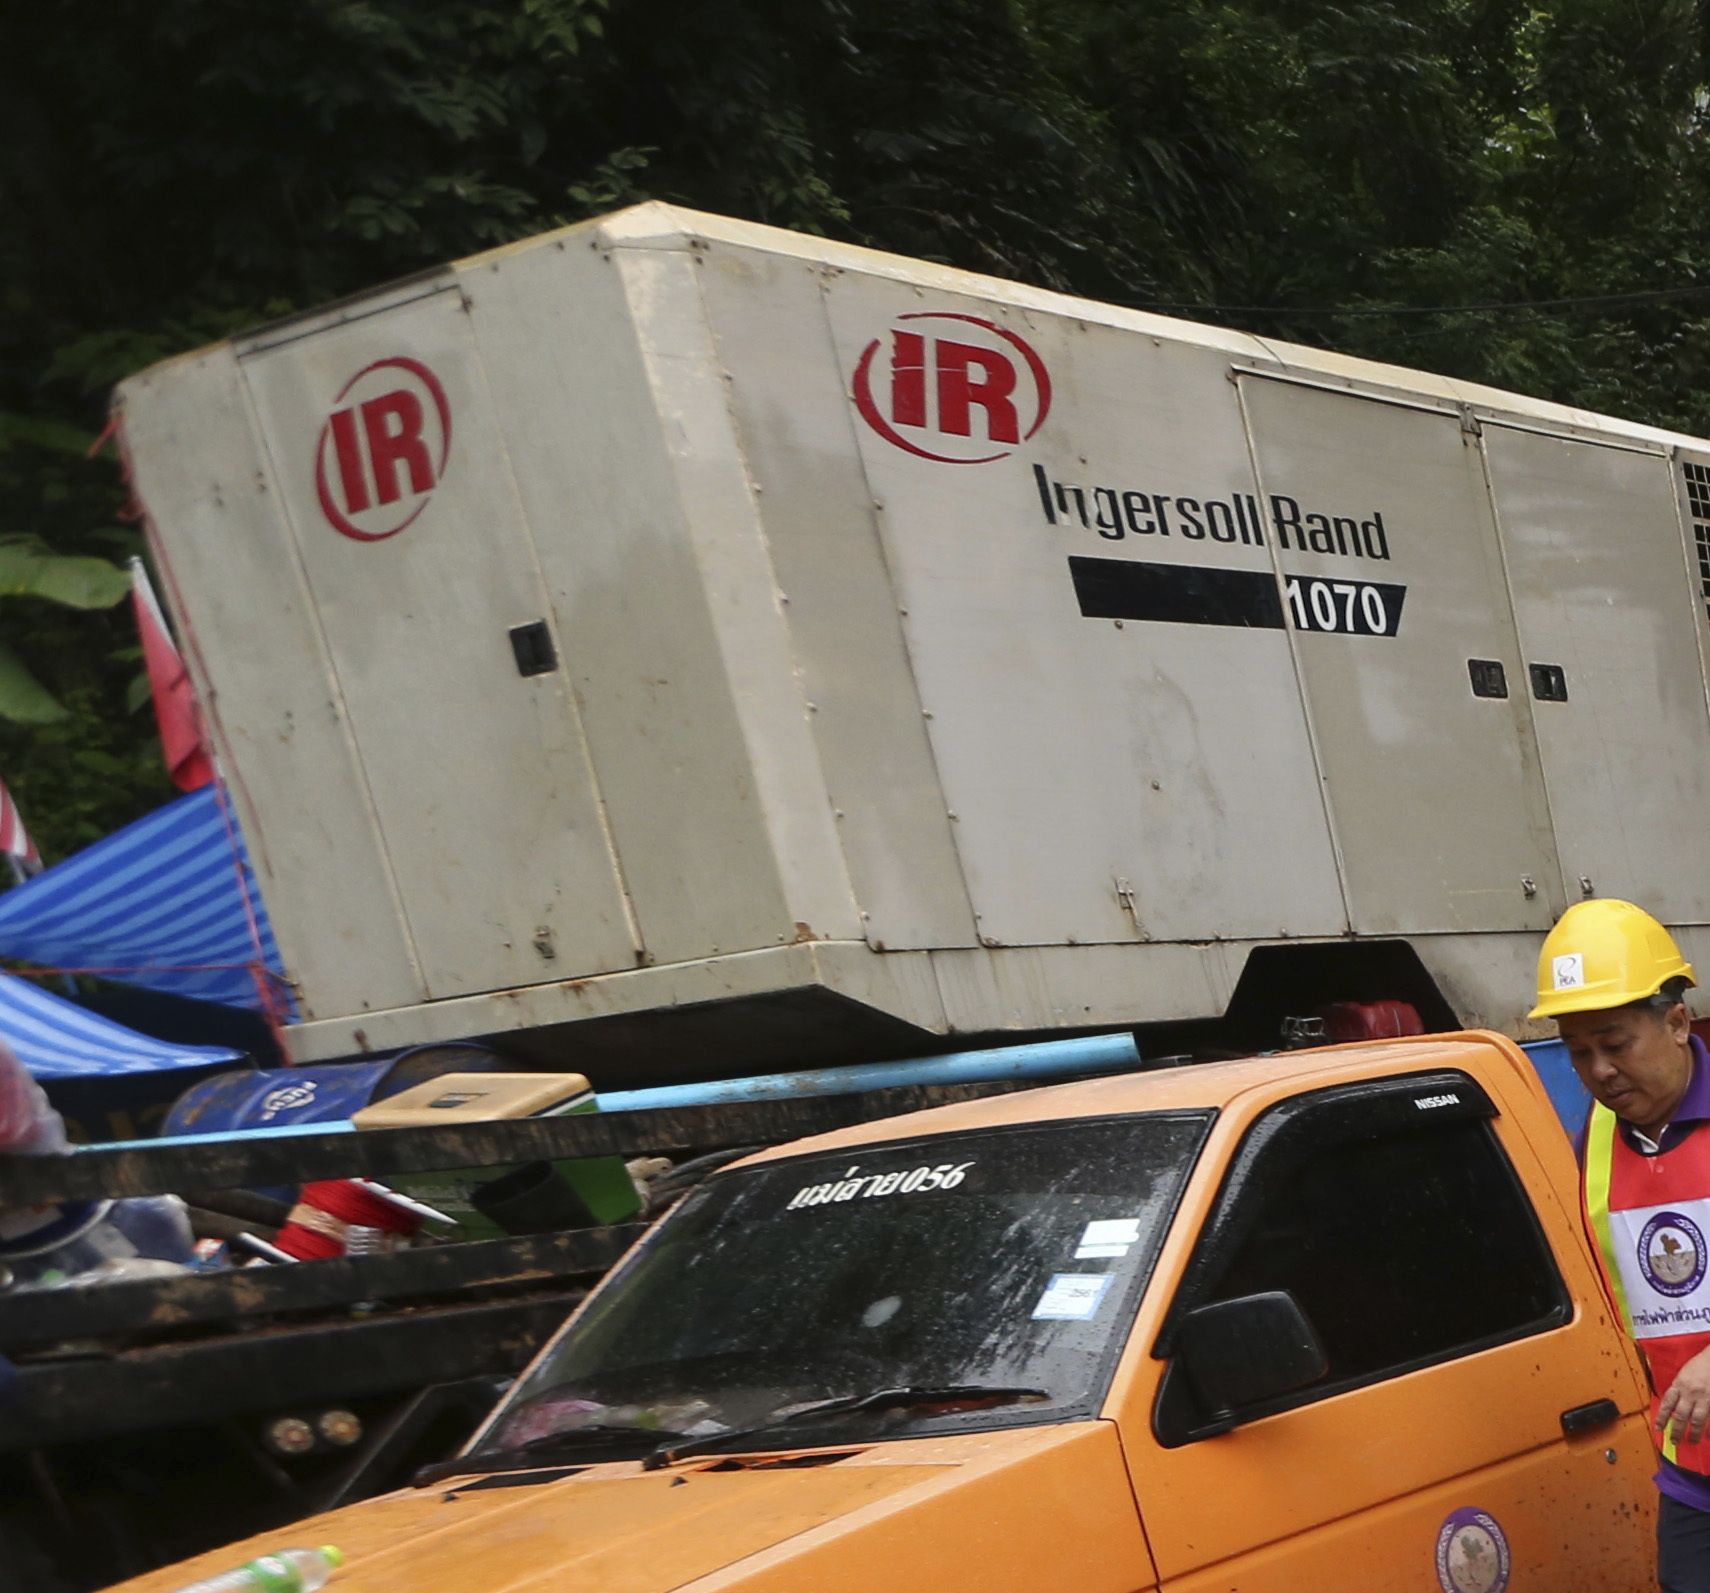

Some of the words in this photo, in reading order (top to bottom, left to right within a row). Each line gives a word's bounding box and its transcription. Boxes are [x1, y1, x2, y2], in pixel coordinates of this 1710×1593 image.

[891, 328, 1021, 445] IR
[330, 388, 435, 516] IR
[1032, 463, 1268, 548] Ingersoll
[1274, 495, 1392, 561] Rand
[1286, 579, 1388, 635] 1070
